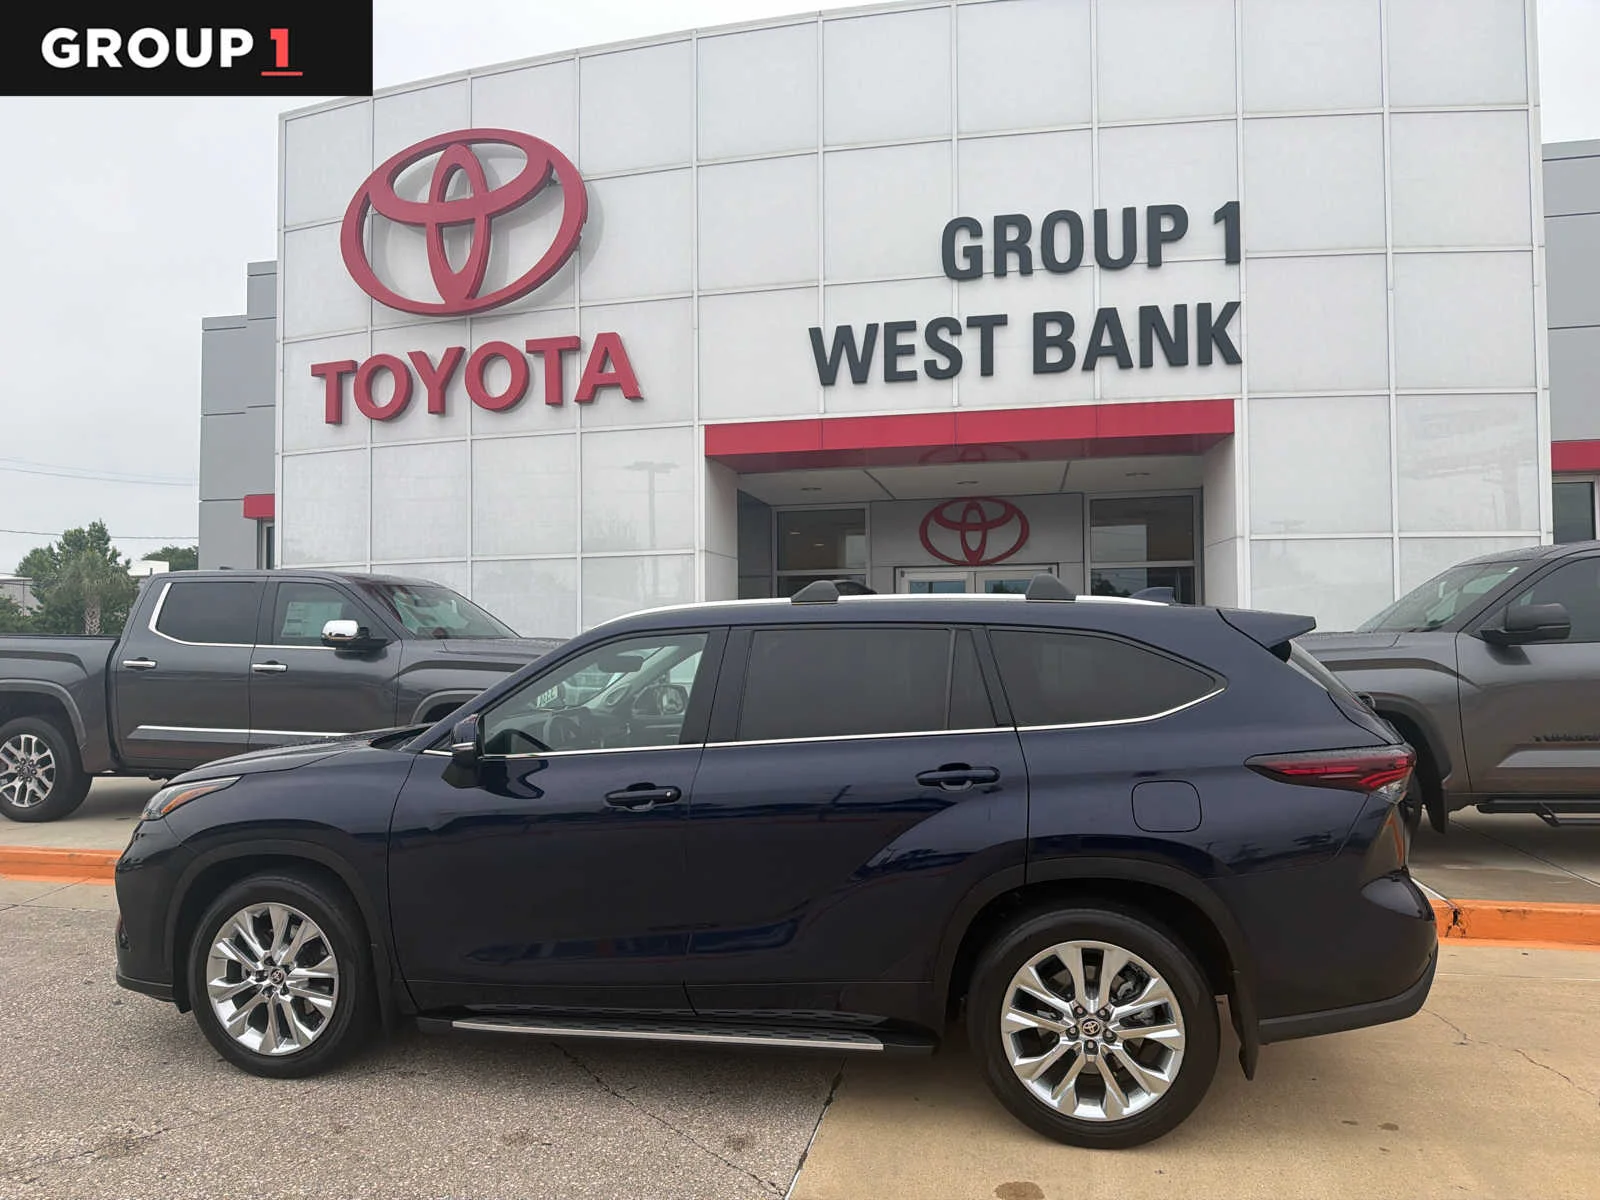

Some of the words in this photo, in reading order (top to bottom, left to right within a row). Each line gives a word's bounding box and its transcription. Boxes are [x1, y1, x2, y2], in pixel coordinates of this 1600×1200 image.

[941, 203, 1189, 281] GROUP
[1213, 200, 1241, 265] 1
[310, 331, 643, 425] TOYOTA
[808, 313, 1008, 386] WEST
[1032, 301, 1243, 375] BANK
